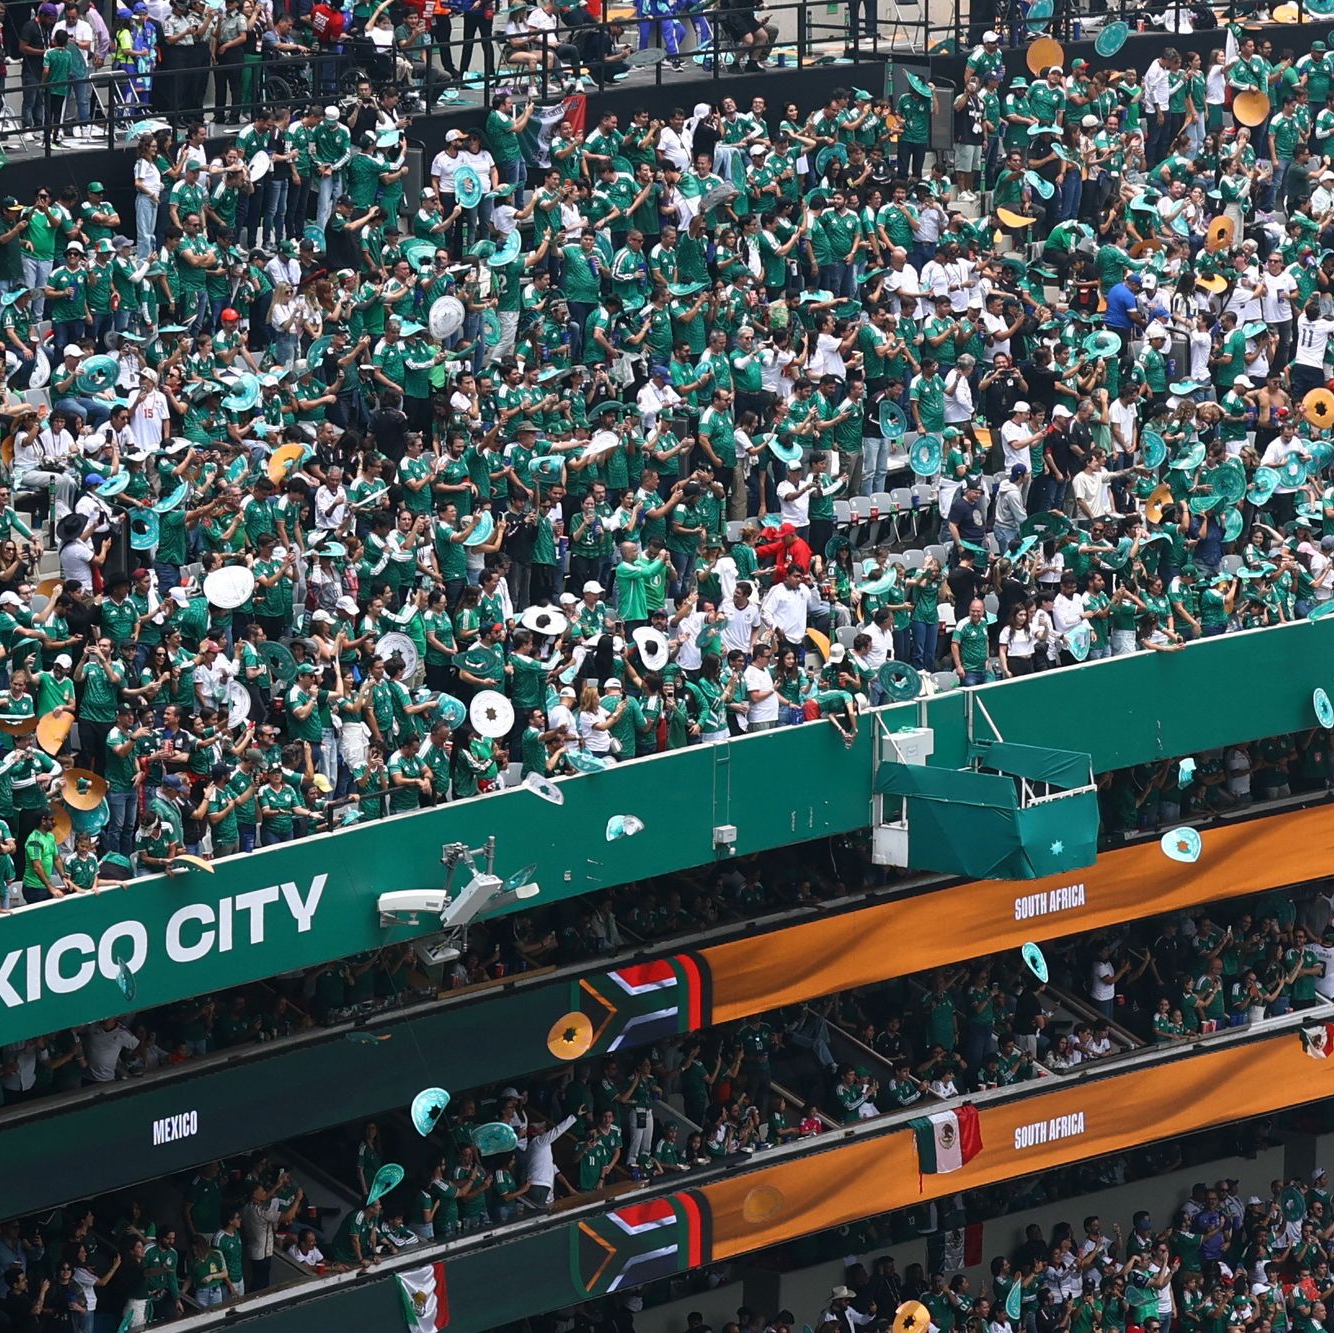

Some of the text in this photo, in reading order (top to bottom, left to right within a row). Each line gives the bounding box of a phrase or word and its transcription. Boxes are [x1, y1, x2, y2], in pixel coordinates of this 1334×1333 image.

[143, 408, 153, 418] 15
[165, 873, 328, 963] CITY
[1014, 884, 1085, 921] SOUTH AFRICA
[153, 1110, 198, 1146] MEXICO
[1014, 1111, 1085, 1150] SOUTH AFRICA
